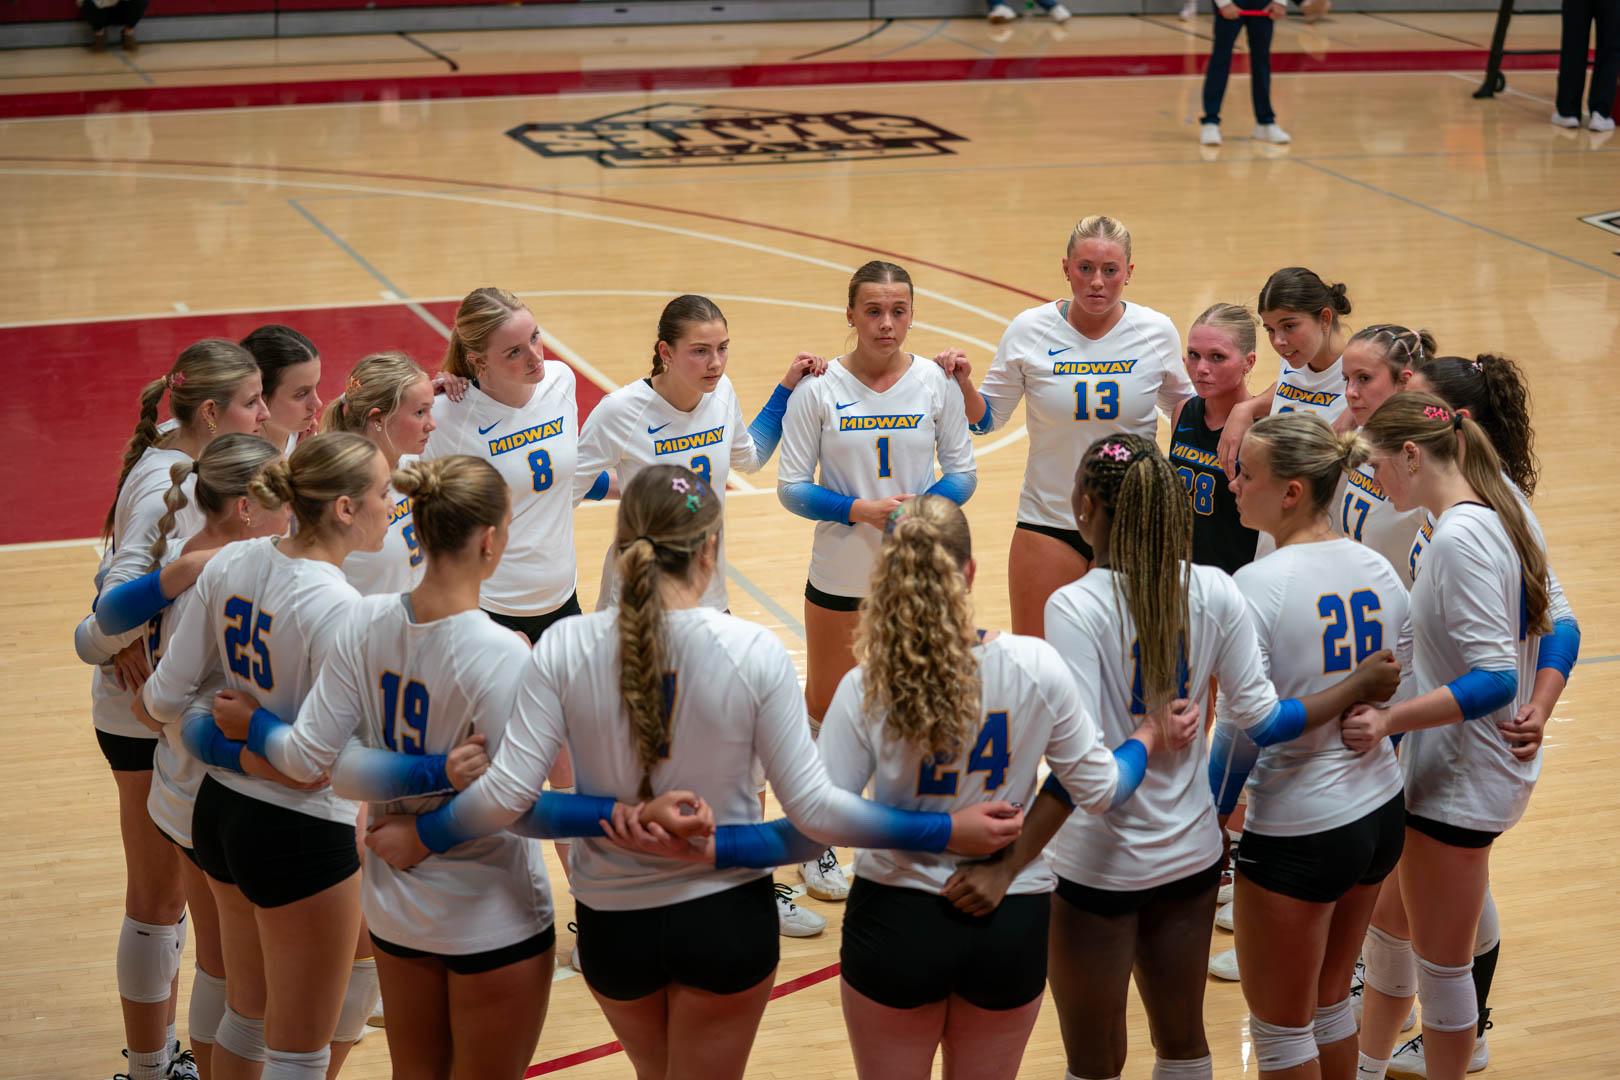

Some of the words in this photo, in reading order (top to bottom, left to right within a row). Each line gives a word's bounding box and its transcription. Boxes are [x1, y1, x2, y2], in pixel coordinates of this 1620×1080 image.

[1053, 359, 1137, 375] MIDWAY
[1073, 380, 1121, 421] 13
[1277, 382, 1339, 406] MIDWAY
[490, 417, 563, 455] MIDWAY
[655, 426, 724, 455] MIDWAY
[840, 414, 923, 431] MIDWAY
[527, 448, 554, 494] 8
[875, 435, 892, 479] 1
[1171, 442, 1227, 471] MIDWA
[1349, 470, 1386, 500] IDWA
[1342, 490, 1373, 544] 17
[223, 593, 275, 693] 25
[1316, 588, 1383, 675] 26
[379, 670, 430, 755] 19
[916, 709, 1011, 797] 24
